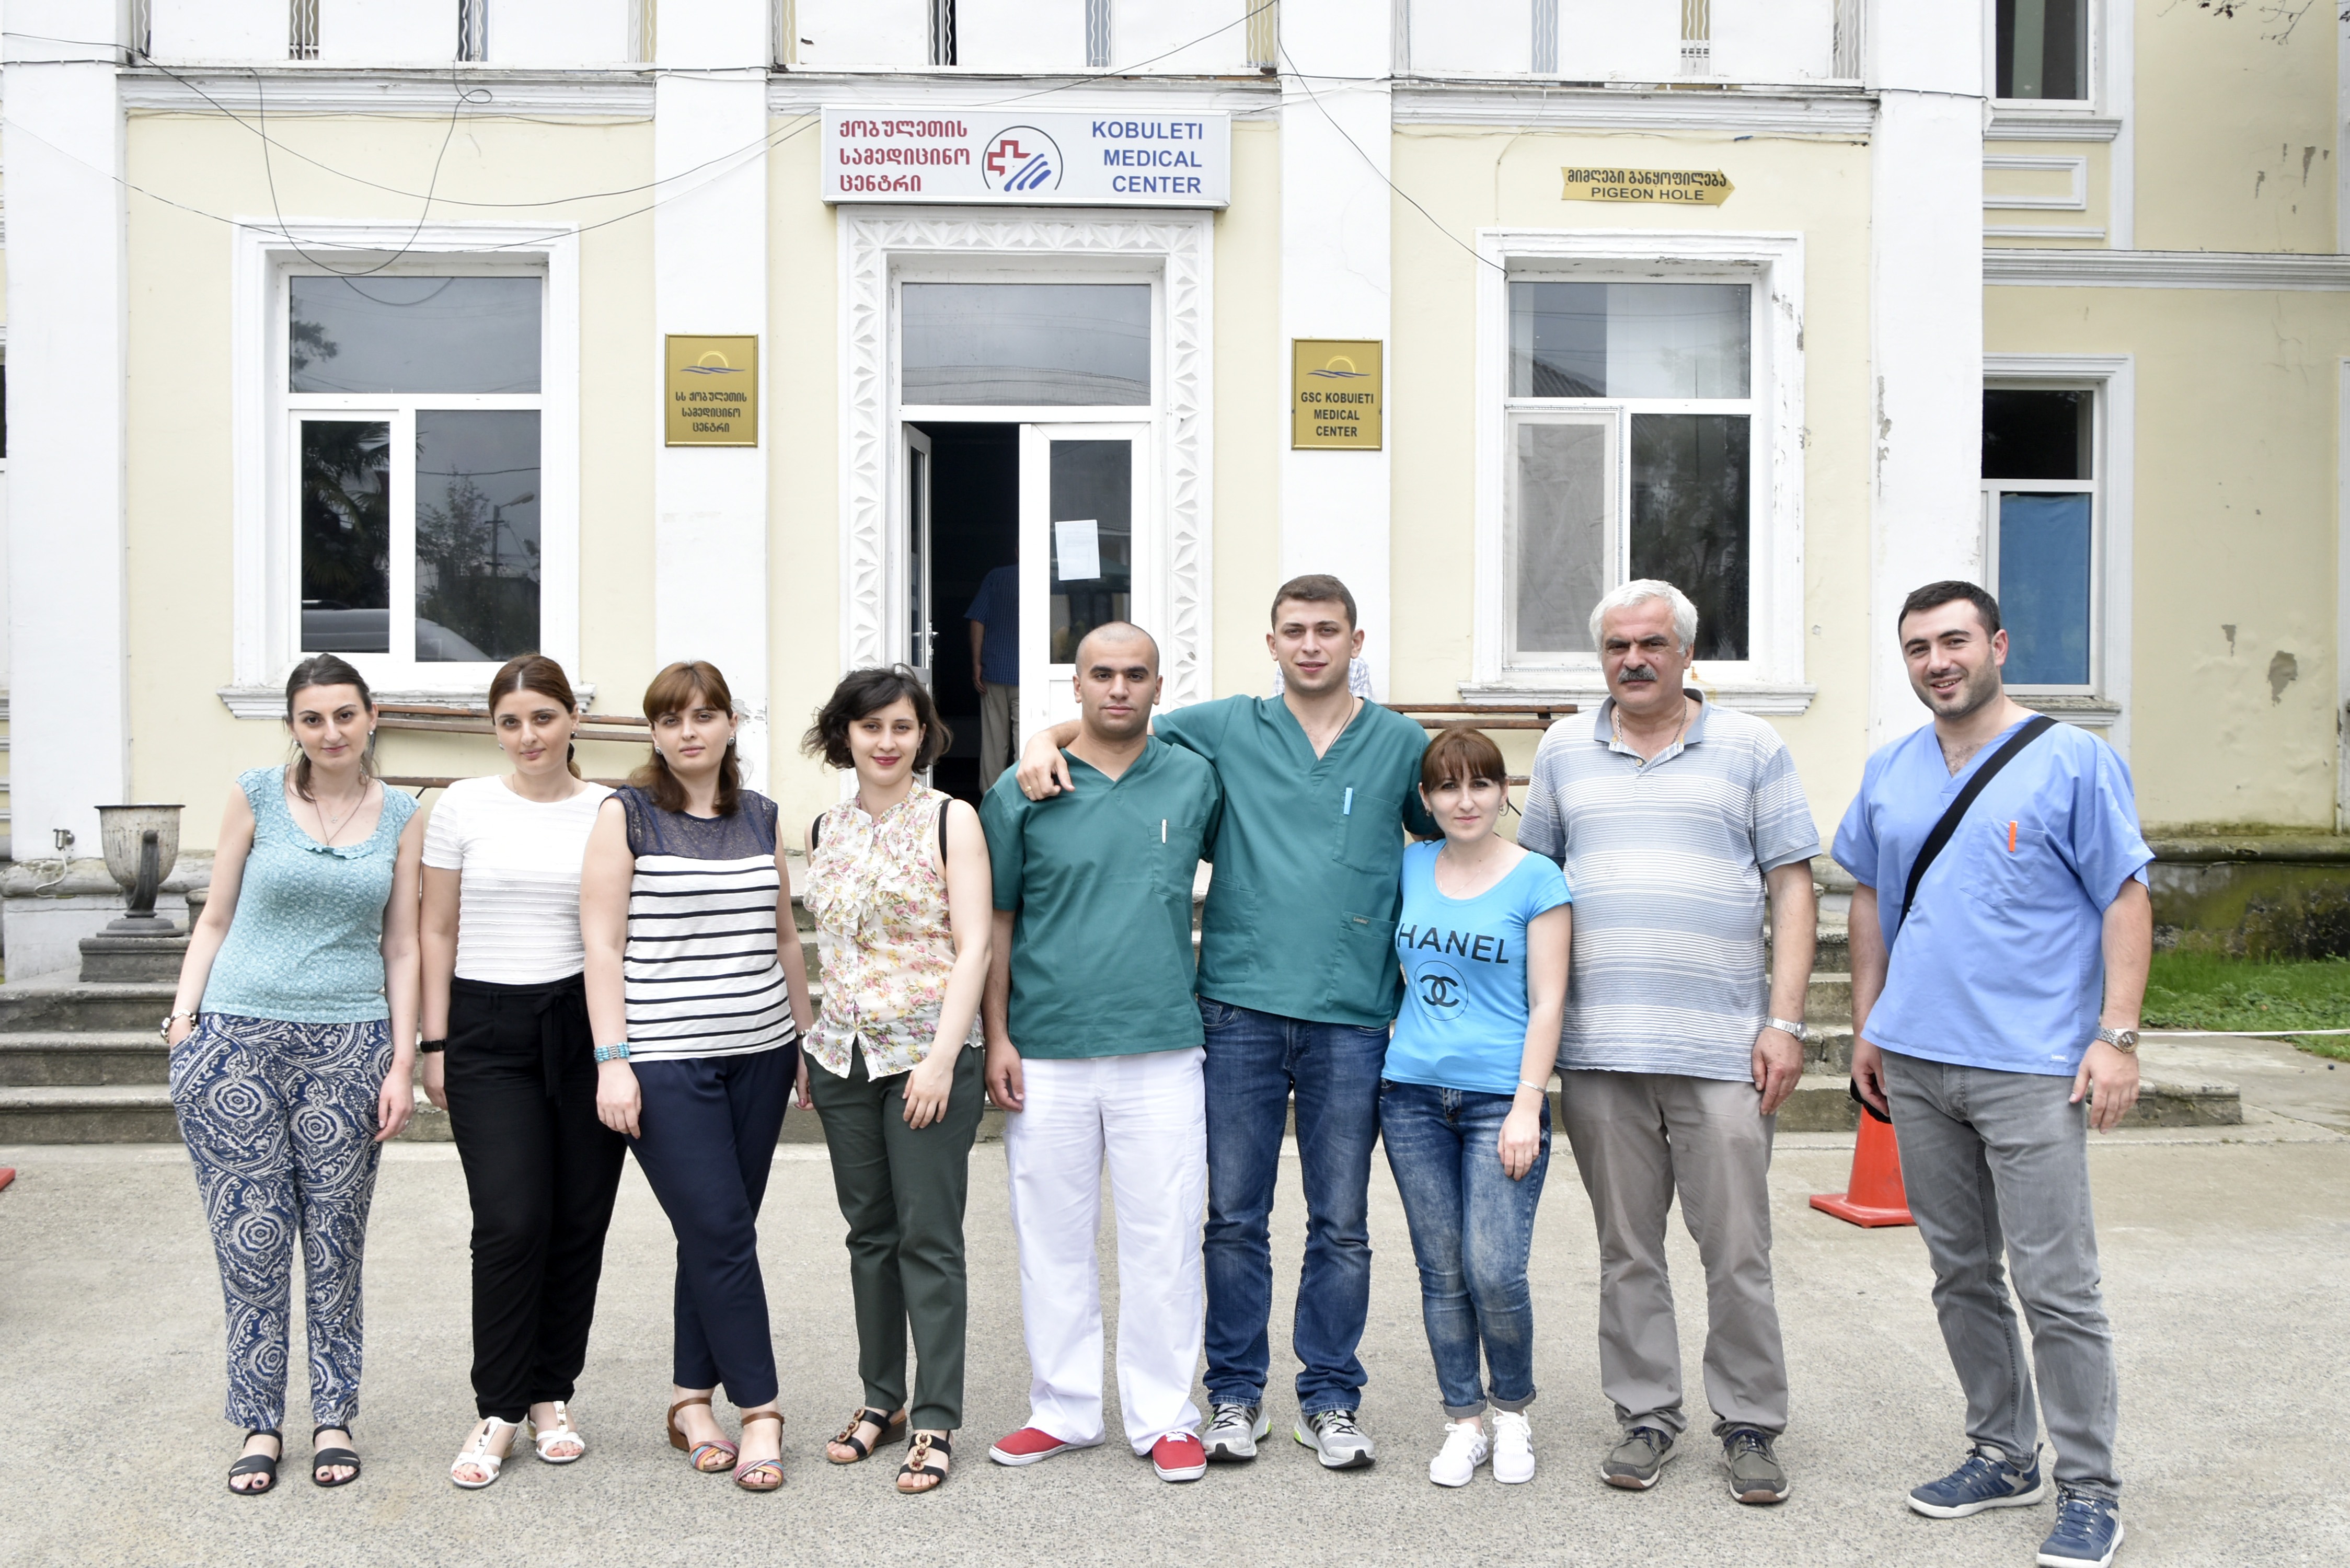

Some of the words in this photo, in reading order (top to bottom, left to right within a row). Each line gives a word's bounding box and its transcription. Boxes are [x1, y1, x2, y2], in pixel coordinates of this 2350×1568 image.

[839, 120, 967, 137] ქობულეთის
[1092, 121, 1203, 140] KOBULETI
[840, 148, 970, 165] სამედიცინო
[1104, 149, 1202, 168] MEDICAL
[840, 175, 921, 192] ცენტრი
[1112, 175, 1201, 193] CENTER
[1568, 169, 1625, 183] მიმღები
[1628, 171, 1726, 187] განყოფილება
[1591, 187, 1653, 199] PIGEON
[1660, 190, 1704, 201] HOLE
[675, 391, 686, 401] სს
[1300, 391, 1322, 403] GSC
[682, 407, 741, 418] სამედიცინო
[1314, 409, 1360, 420] MEDICAL
[693, 422, 730, 433] ცენტრი
[1316, 425, 1357, 437] CENTER
[1397, 923, 1510, 964] HANEL
